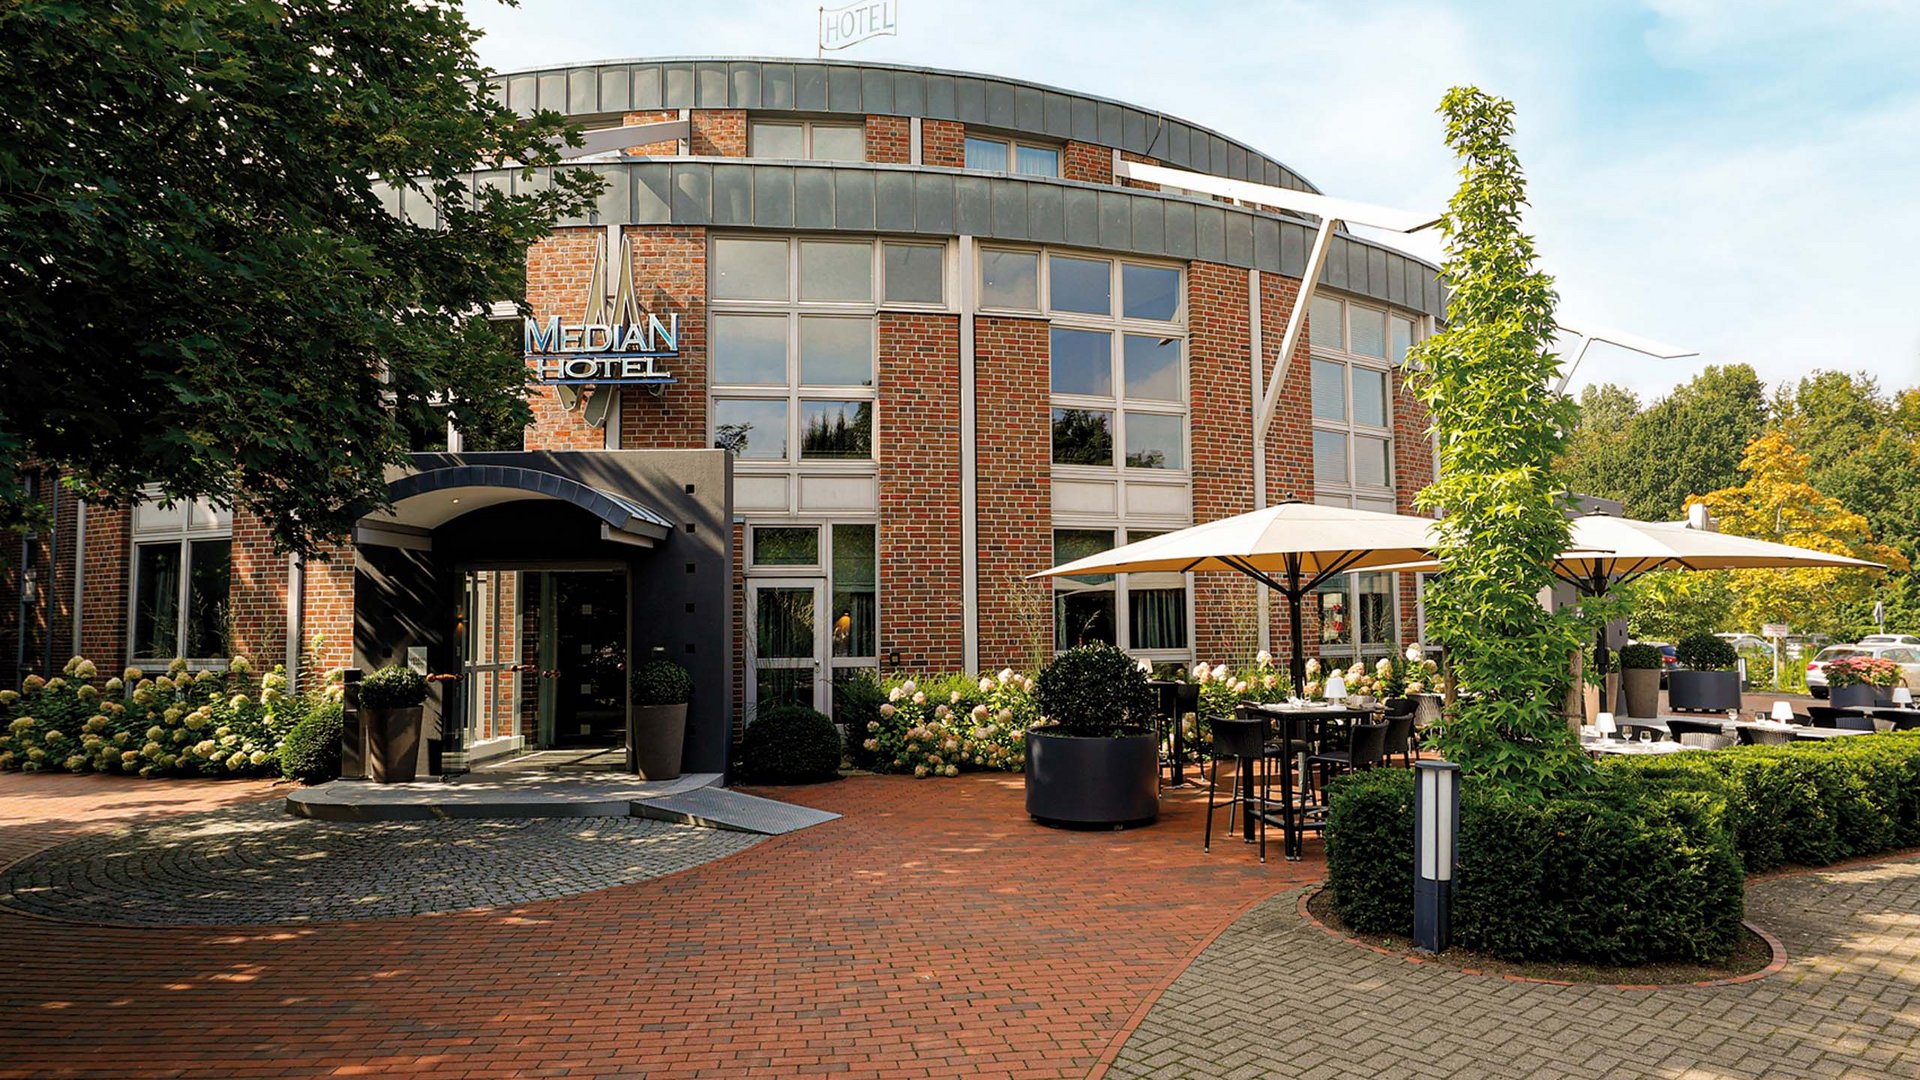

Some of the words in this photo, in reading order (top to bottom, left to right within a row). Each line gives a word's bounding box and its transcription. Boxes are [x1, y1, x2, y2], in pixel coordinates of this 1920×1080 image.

[826, 2, 894, 43] HOTEL
[524, 313, 679, 354] MEDIAN
[536, 357, 671, 378] HOTEL
